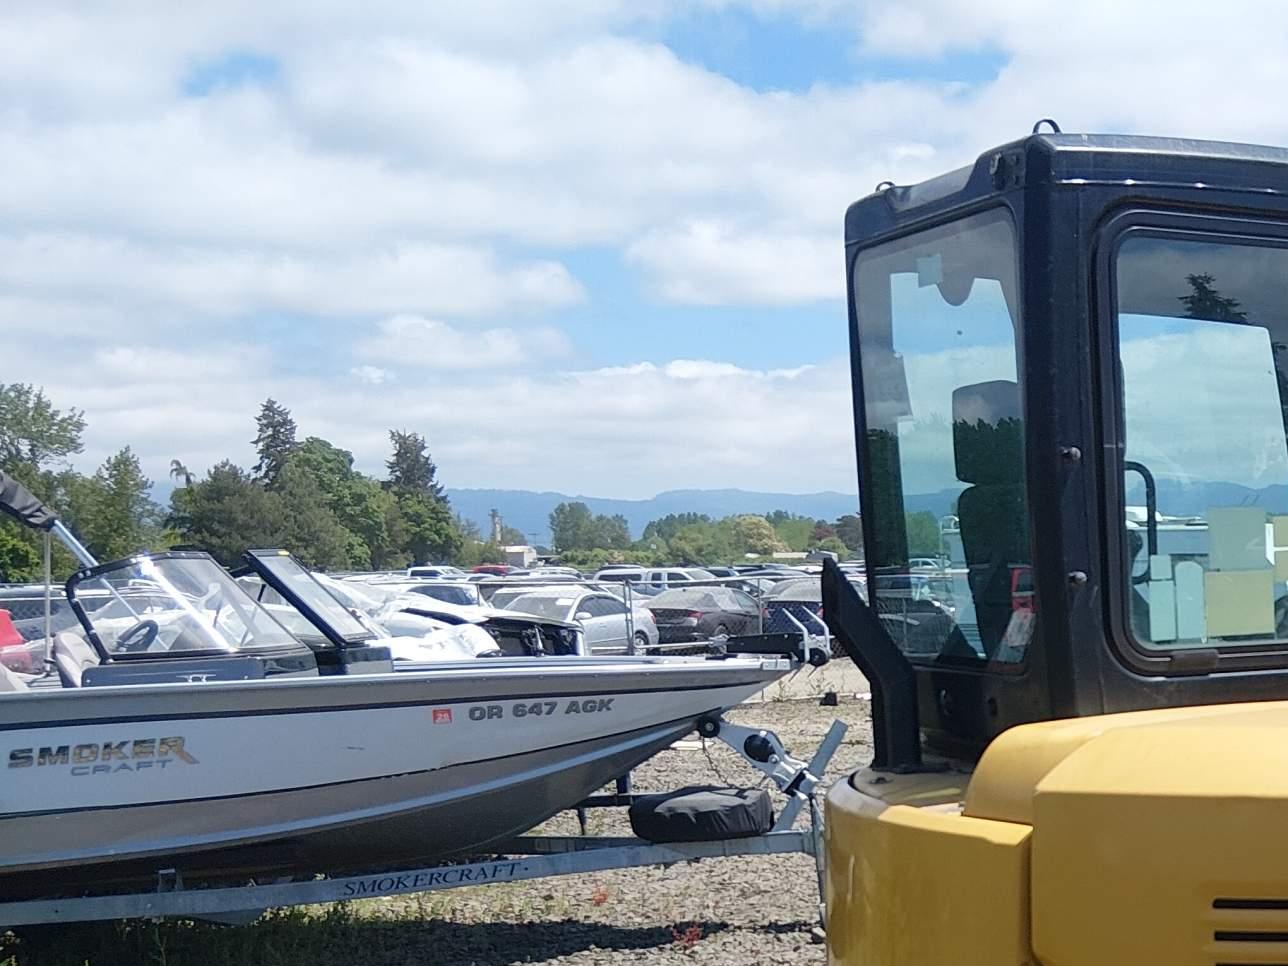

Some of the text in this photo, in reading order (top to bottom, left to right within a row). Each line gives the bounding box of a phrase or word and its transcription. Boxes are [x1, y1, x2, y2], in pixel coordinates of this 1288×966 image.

[468, 698, 616, 721] OR 647 AGK
[7, 735, 201, 770] SMOKER
[70, 759, 173, 777] CRAFT
[343, 862, 522, 897] SMOKERCRAFT
